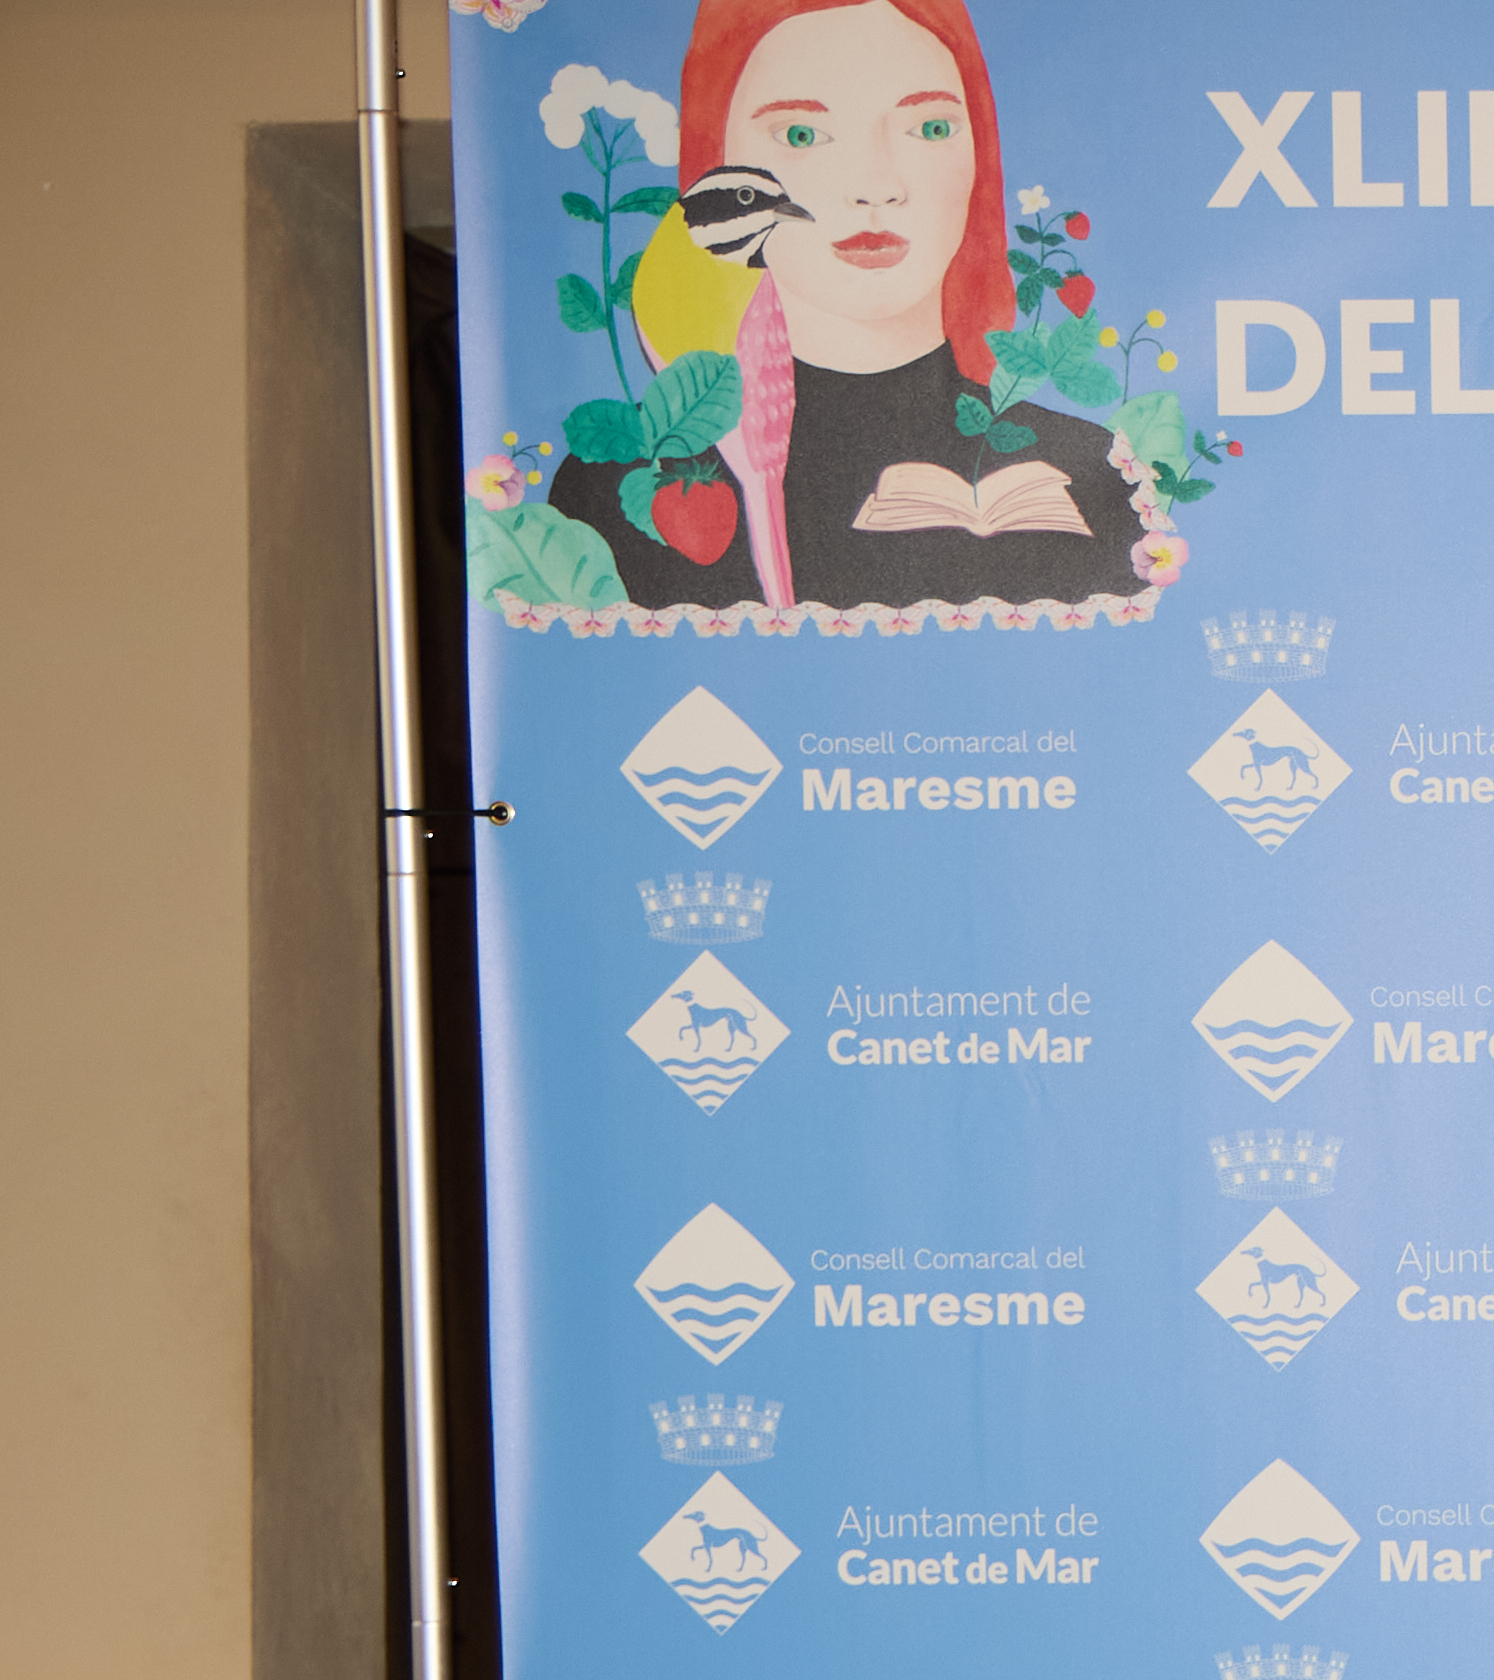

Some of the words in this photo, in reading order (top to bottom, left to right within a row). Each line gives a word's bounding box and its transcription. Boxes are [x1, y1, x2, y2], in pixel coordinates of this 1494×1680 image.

[799, 731, 894, 753] Consell
[904, 731, 1029, 753] Comarcal
[1038, 730, 1076, 753] del
[803, 769, 1074, 810] Maresme
[826, 984, 1037, 1020] Ajuntament
[1047, 984, 1091, 1017] de
[827, 1029, 949, 1065] Canet
[958, 1032, 1000, 1064] de
[1008, 1029, 1090, 1064] Mar
[1376, 1503, 1471, 1525] Consell
